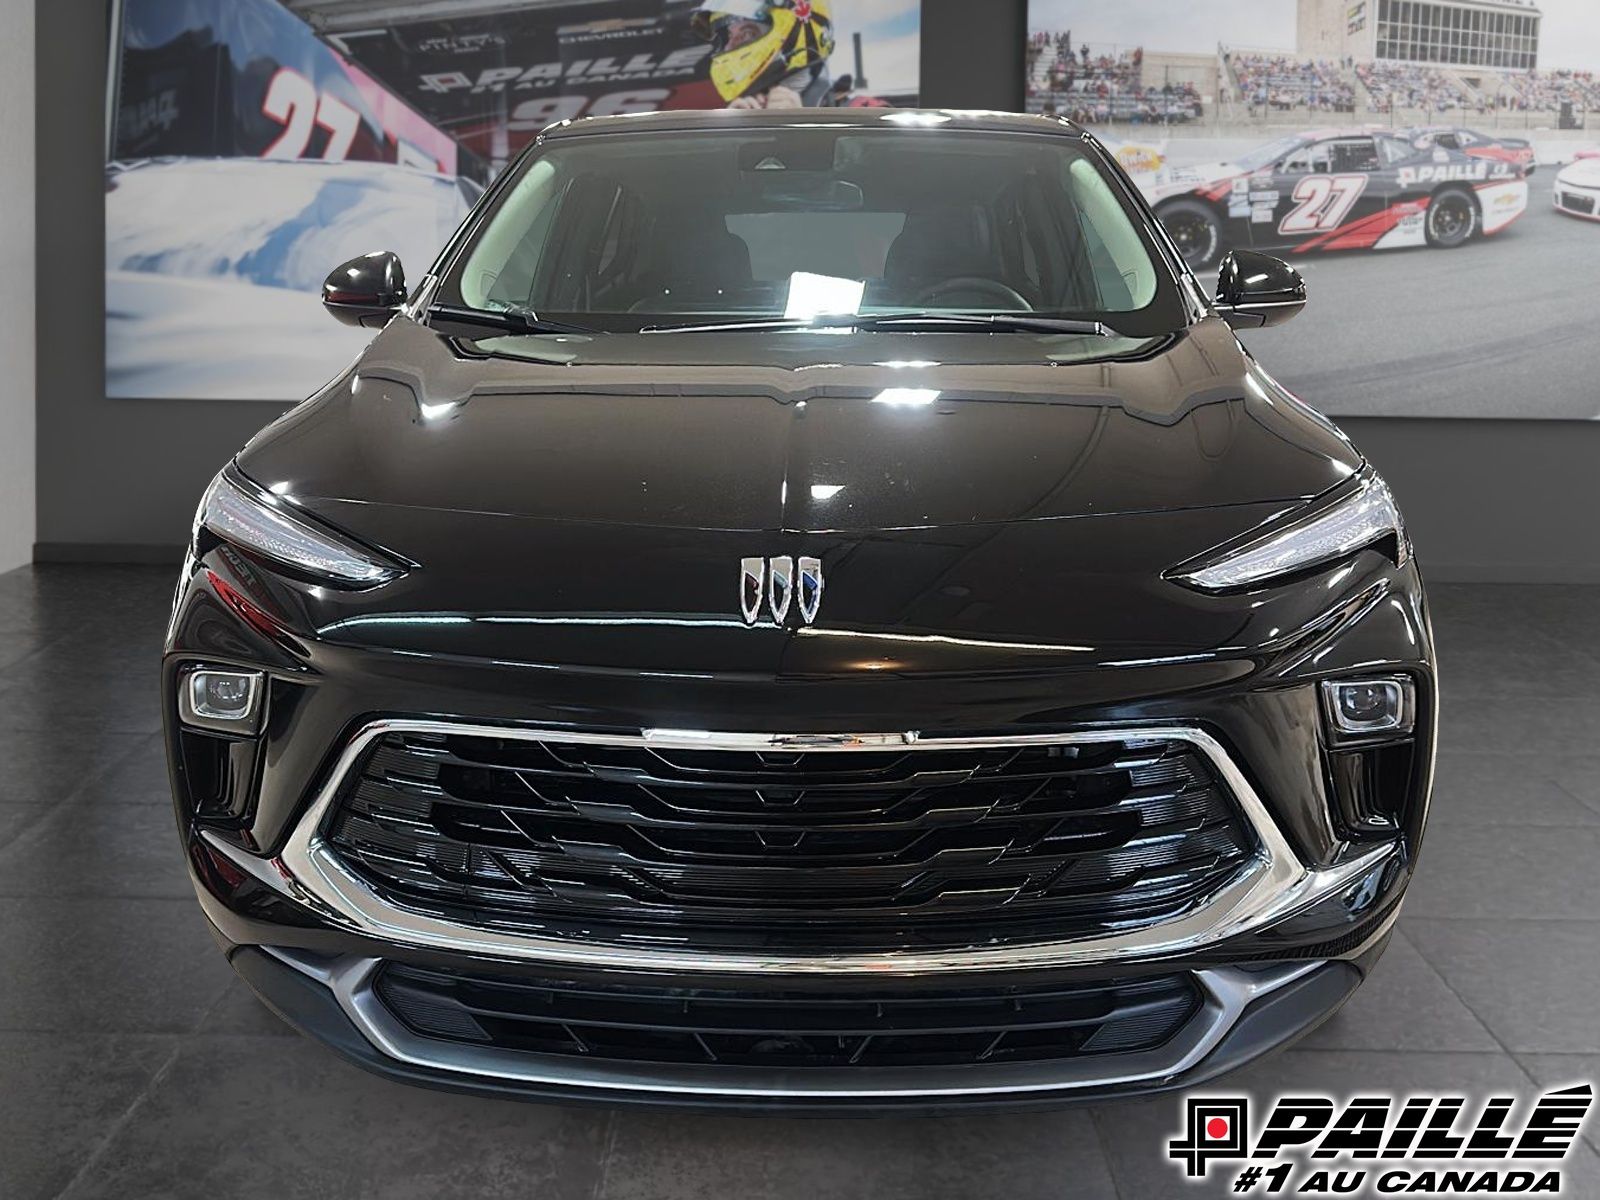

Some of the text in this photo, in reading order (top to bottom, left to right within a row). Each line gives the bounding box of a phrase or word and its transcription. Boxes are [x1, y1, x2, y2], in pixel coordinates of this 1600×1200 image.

[558, 27, 665, 45] CHEVROLET
[564, 66, 696, 86] CANADA
[261, 66, 362, 162] 27
[506, 88, 673, 131] 96
[1277, 172, 1370, 235] 27
